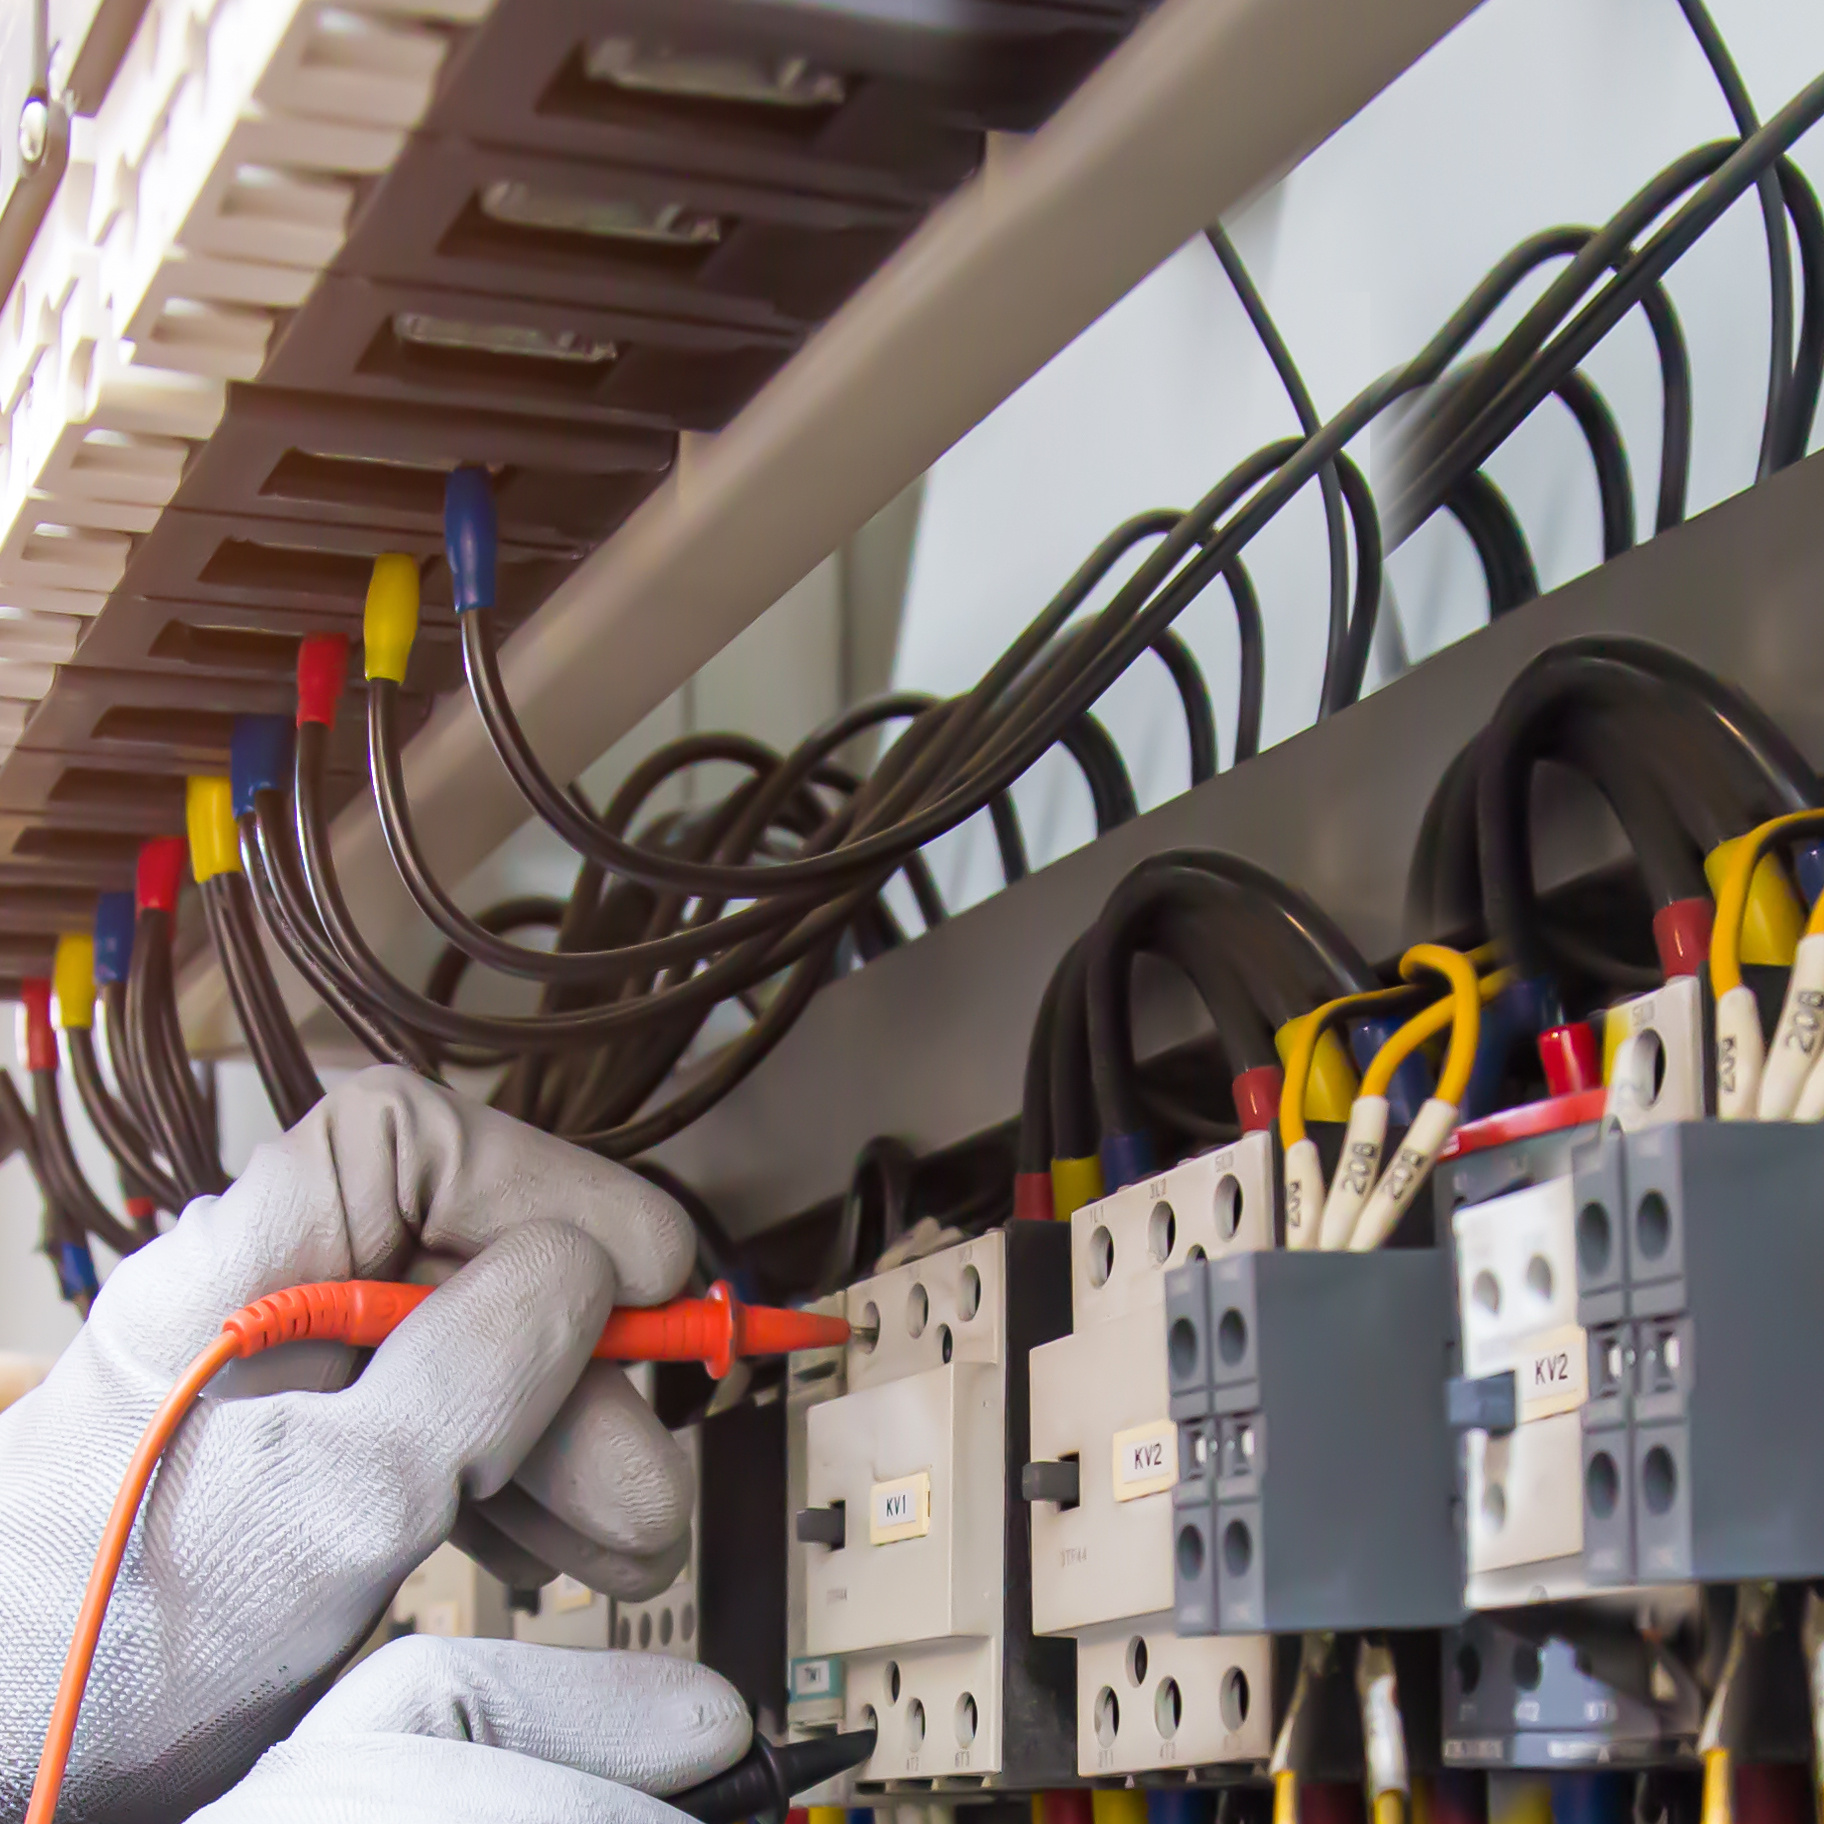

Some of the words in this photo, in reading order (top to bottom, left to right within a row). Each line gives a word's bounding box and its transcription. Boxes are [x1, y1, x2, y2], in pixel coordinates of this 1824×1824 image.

[1535, 1352, 1570, 1386] KV2
[1134, 1443, 1164, 1470] KV2
[886, 1494, 907, 1517] KV1
